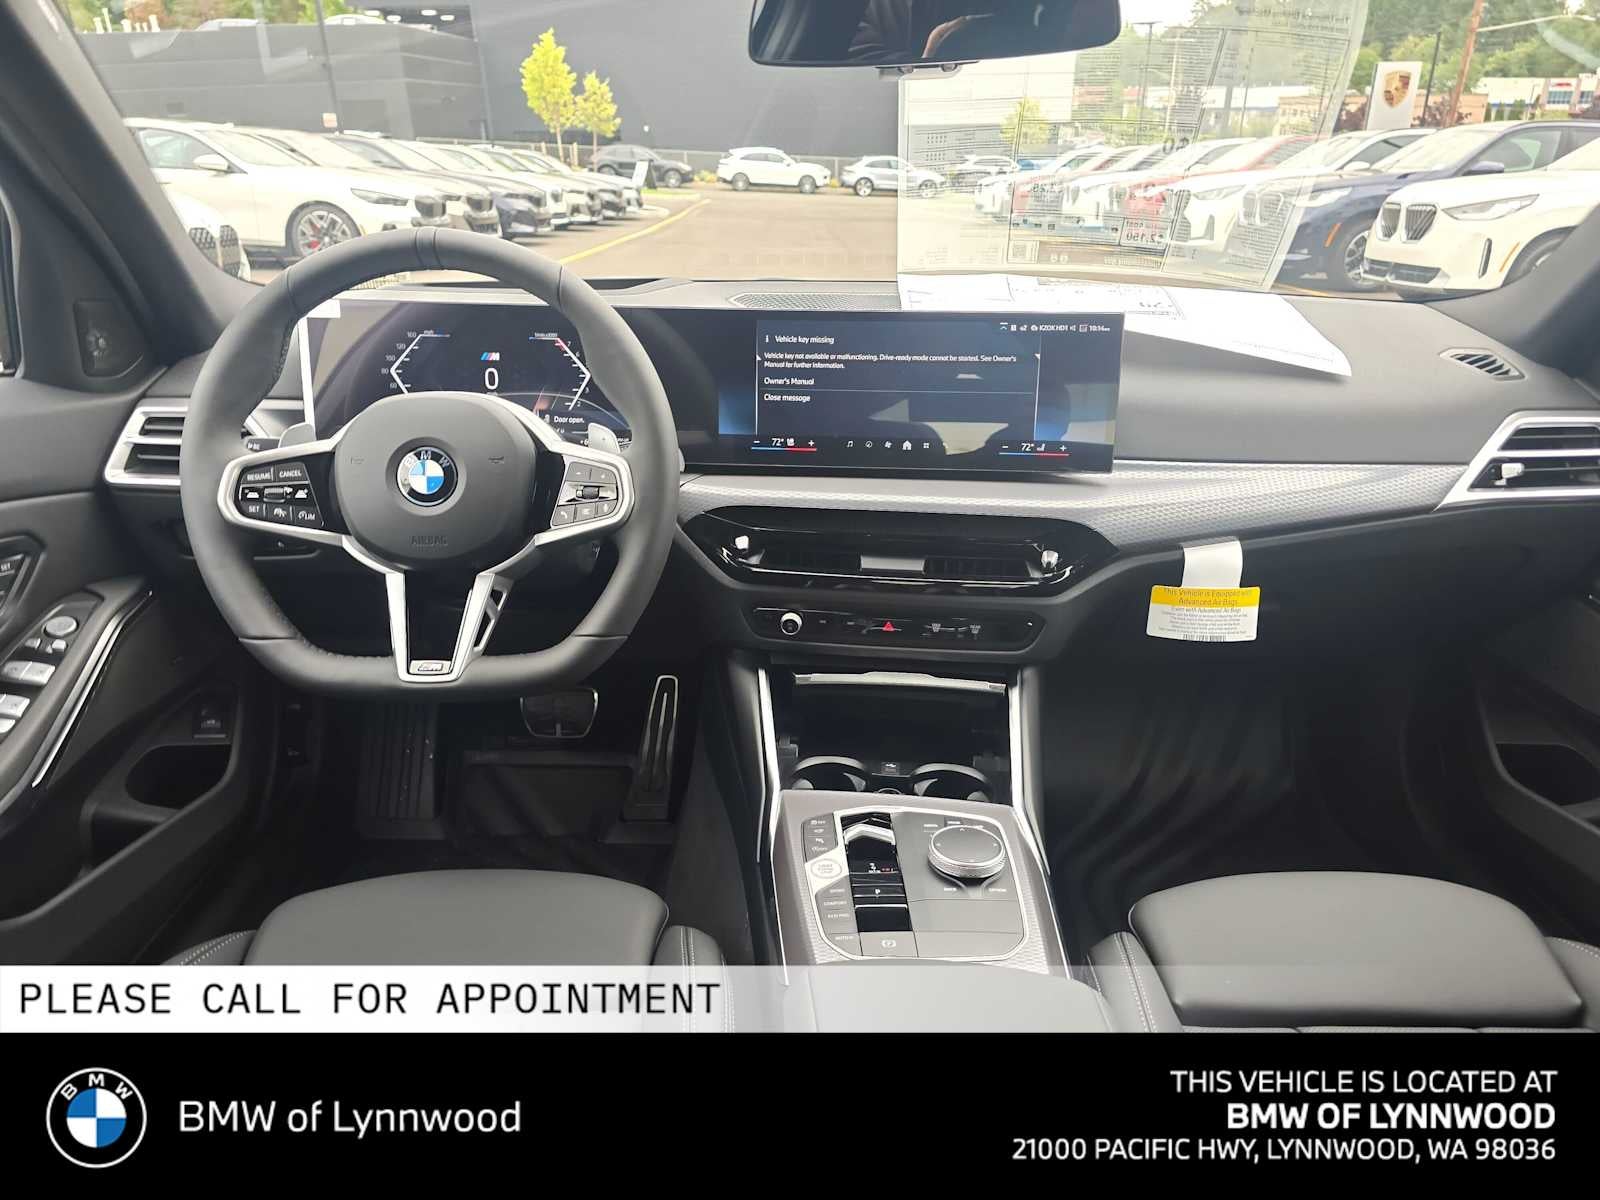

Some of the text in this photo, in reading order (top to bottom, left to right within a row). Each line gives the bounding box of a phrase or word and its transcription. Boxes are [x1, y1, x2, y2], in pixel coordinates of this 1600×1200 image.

[775, 335, 835, 345] Vehicle key missing
[785, 352, 794, 360] key
[795, 352, 804, 360] not
[836, 354, 878, 362] malfunctioning.
[880, 354, 912, 362] Drive-ready
[764, 360, 785, 368] Manual
[484, 367, 499, 390] 0
[764, 376, 814, 385] Owner's Manual
[764, 393, 782, 402] Close
[568, 416, 584, 424] open.
[246, 472, 271, 481] RESUME
[279, 470, 302, 478] CANCEL
[411, 536, 448, 546] AIRBAG
